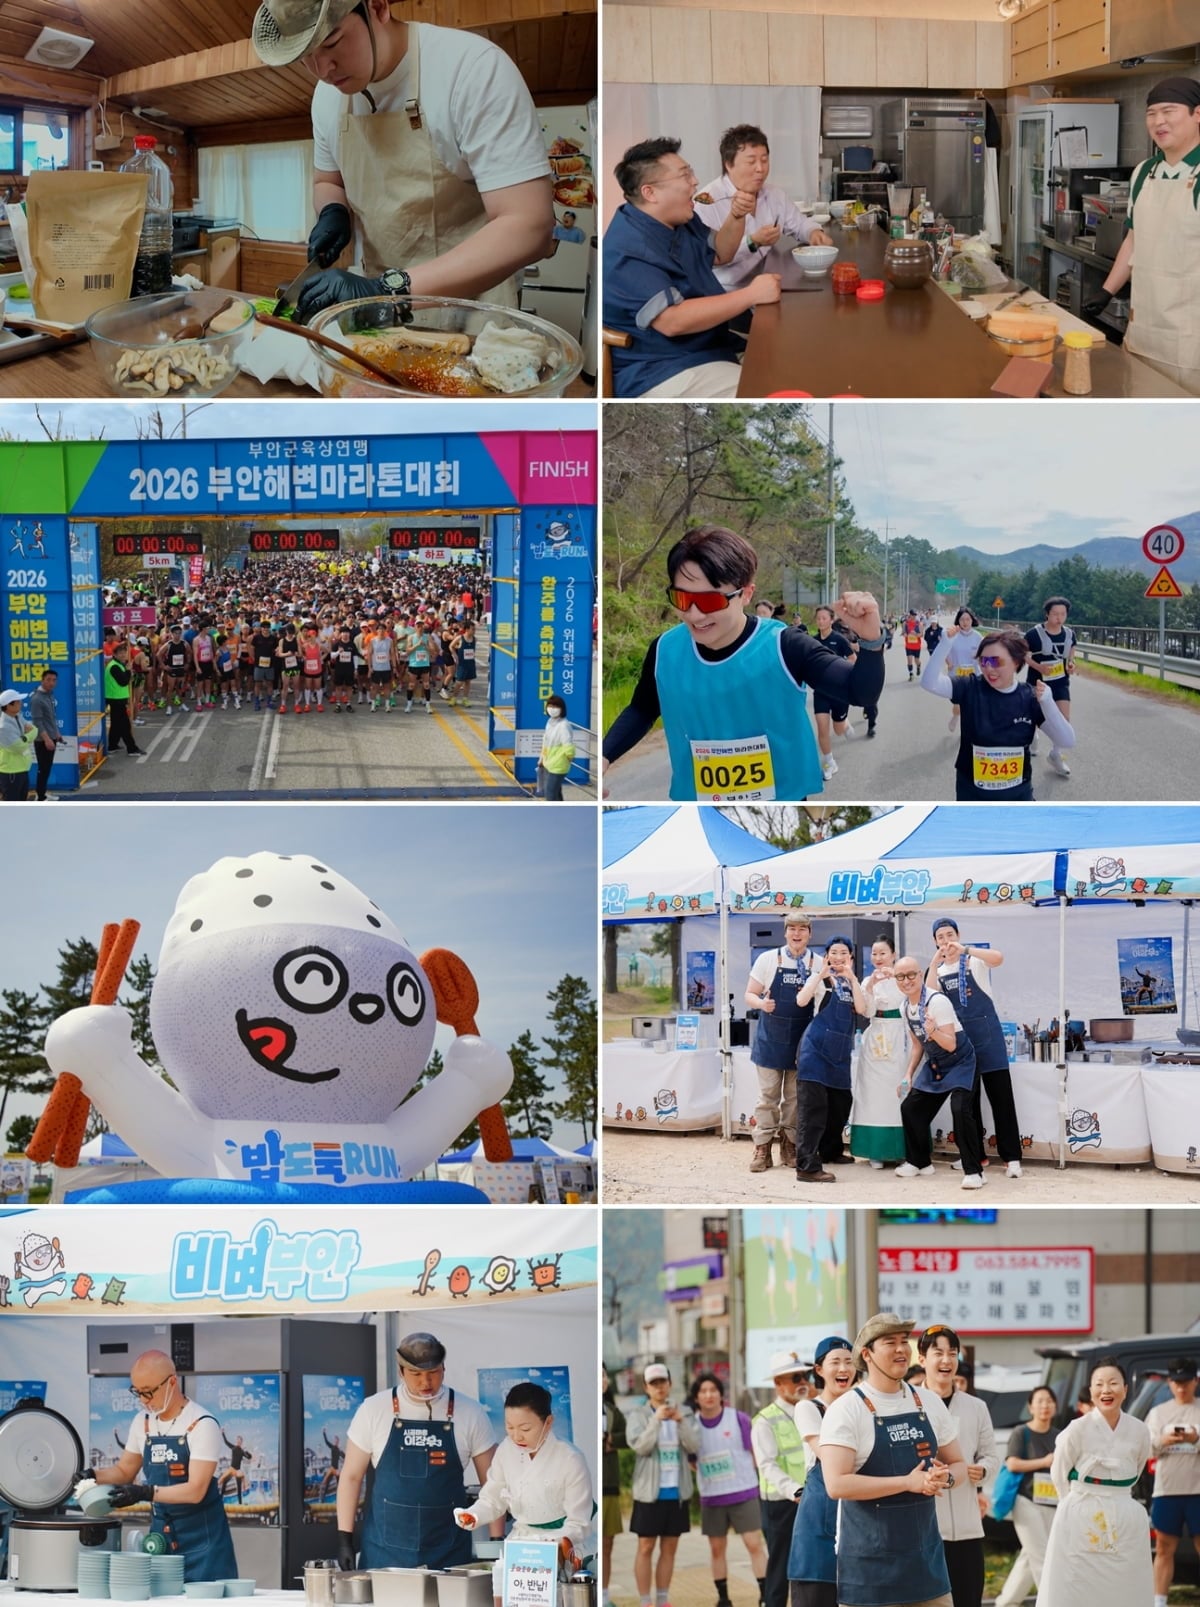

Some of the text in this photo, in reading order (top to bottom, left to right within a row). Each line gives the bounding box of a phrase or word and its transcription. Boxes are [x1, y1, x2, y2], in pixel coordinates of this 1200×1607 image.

[249, 439, 368, 459] 부안군육상연맹
[529, 460, 589, 478] FINISH
[129, 460, 460, 501] 2026 부안해변마라톤대회
[424, 549, 446, 560] 하프
[1152, 534, 1175, 555] 40
[148, 556, 170, 566] 5km
[7, 569, 48, 588] 2026
[8, 593, 48, 615] 부안
[112, 610, 143, 623] 하프
[9, 619, 49, 639] 해변
[562, 576, 576, 695] 2026 위대한 여정
[10, 641, 69, 661] 마라톤
[12, 663, 50, 683] 대회
[700, 761, 766, 788] 0025
[979, 761, 1018, 776] 7343
[527, 1579, 548, 1592] 반납!
